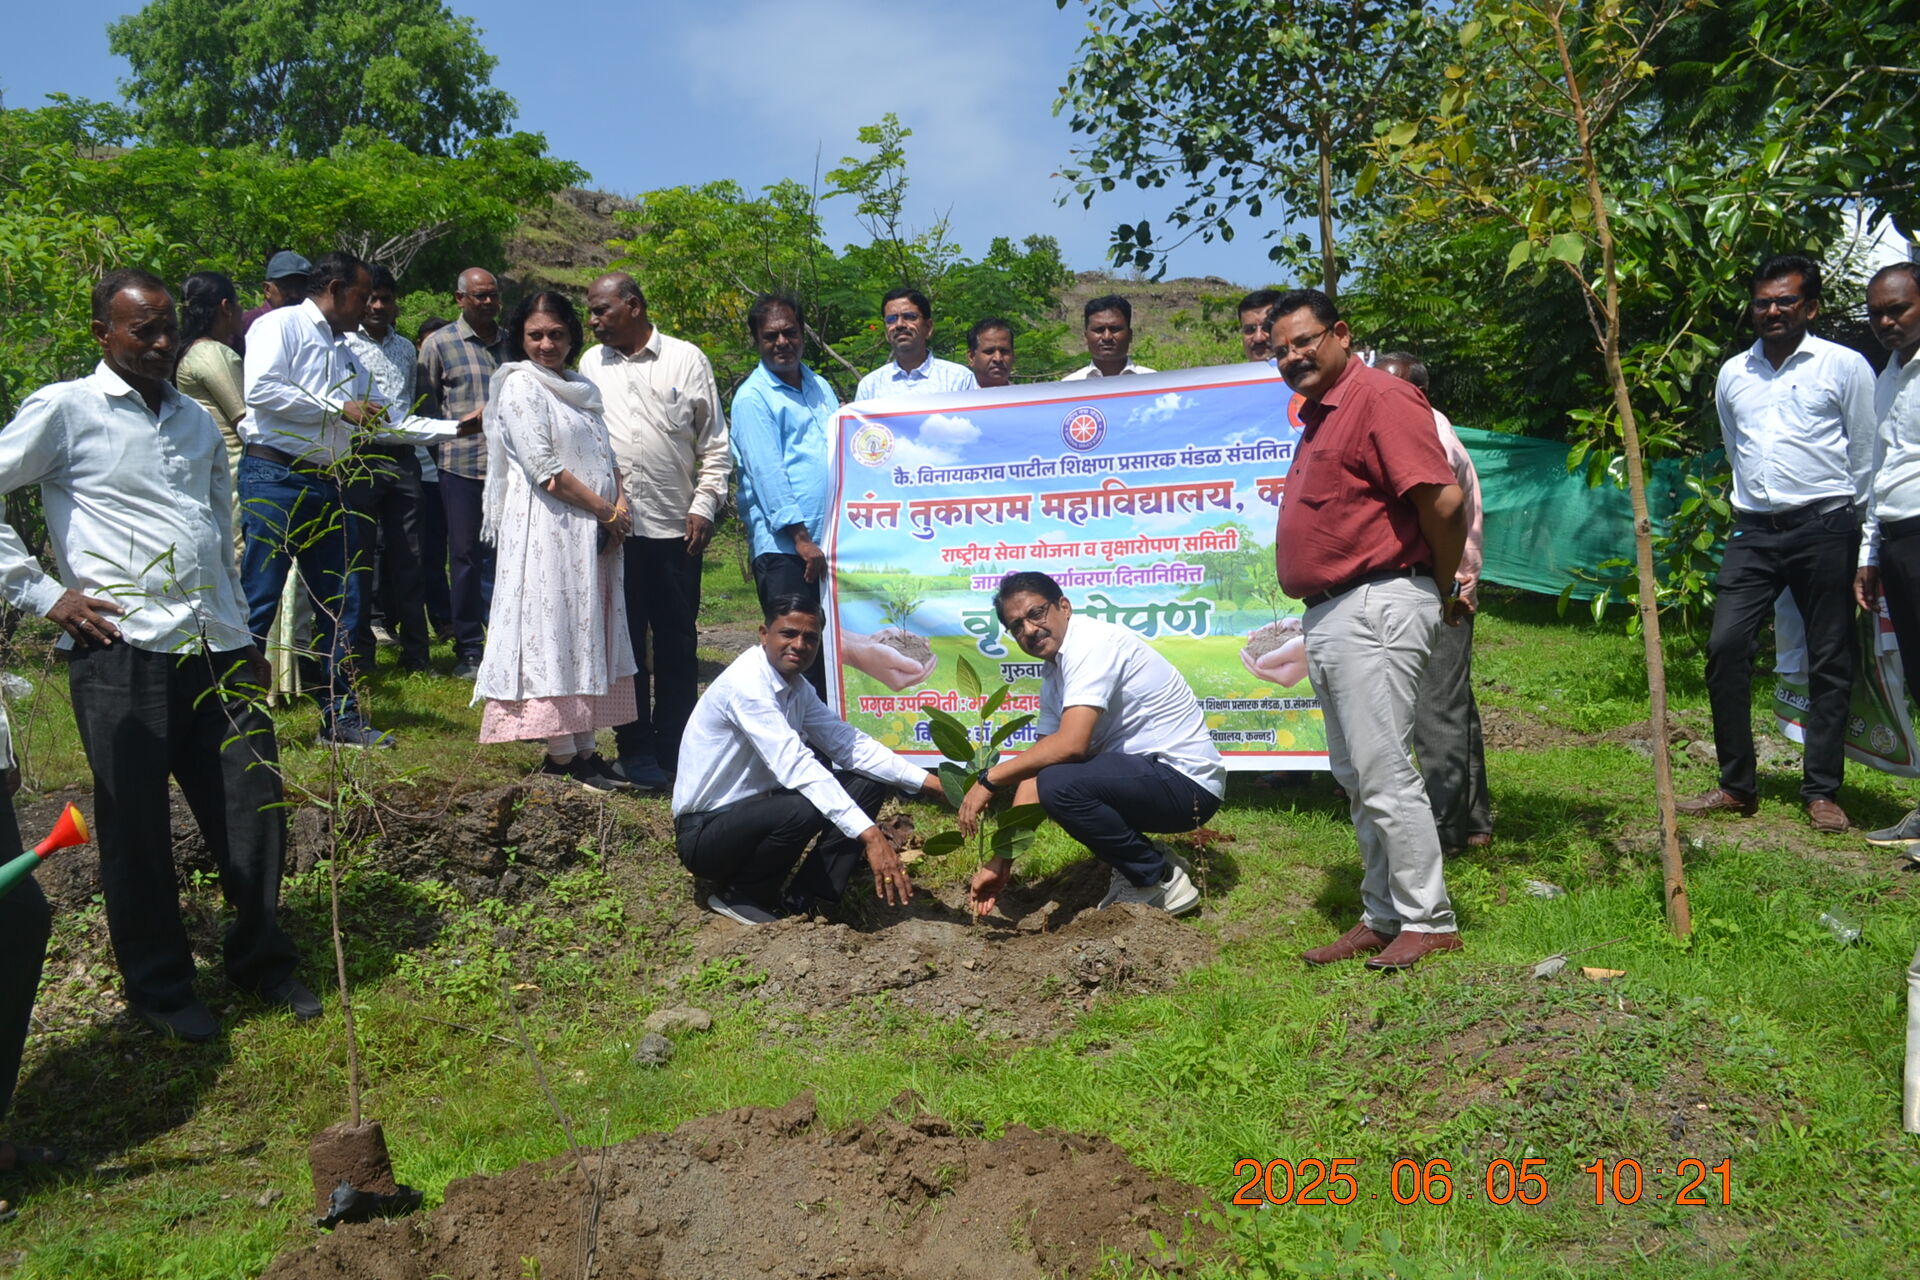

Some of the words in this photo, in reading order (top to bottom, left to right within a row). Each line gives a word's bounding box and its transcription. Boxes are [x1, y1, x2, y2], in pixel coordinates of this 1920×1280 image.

[917, 465, 1005, 484] विनायकराव
[1008, 457, 1056, 478] पाटील
[1060, 455, 1114, 474] शिक्षण
[1118, 451, 1176, 471] प्रसारक
[1180, 446, 1222, 466] मंडळ
[1226, 439, 1292, 462] संचलित
[847, 492, 901, 529] संत
[909, 494, 1032, 540] तुकाराम
[1041, 478, 1244, 526] महाविद्यालय,
[941, 542, 991, 566] राष्ट्रीय
[994, 541, 1026, 560] सेवा
[1030, 540, 1081, 559] योजना
[1084, 542, 1097, 556] व
[1101, 534, 1181, 562] वृक्षारोपण
[1183, 529, 1237, 551] समिती
[1115, 564, 1203, 585] दिनानिमित्त
[1000, 663, 1044, 683] गुरुवा
[859, 695, 896, 716] प्रमुख
